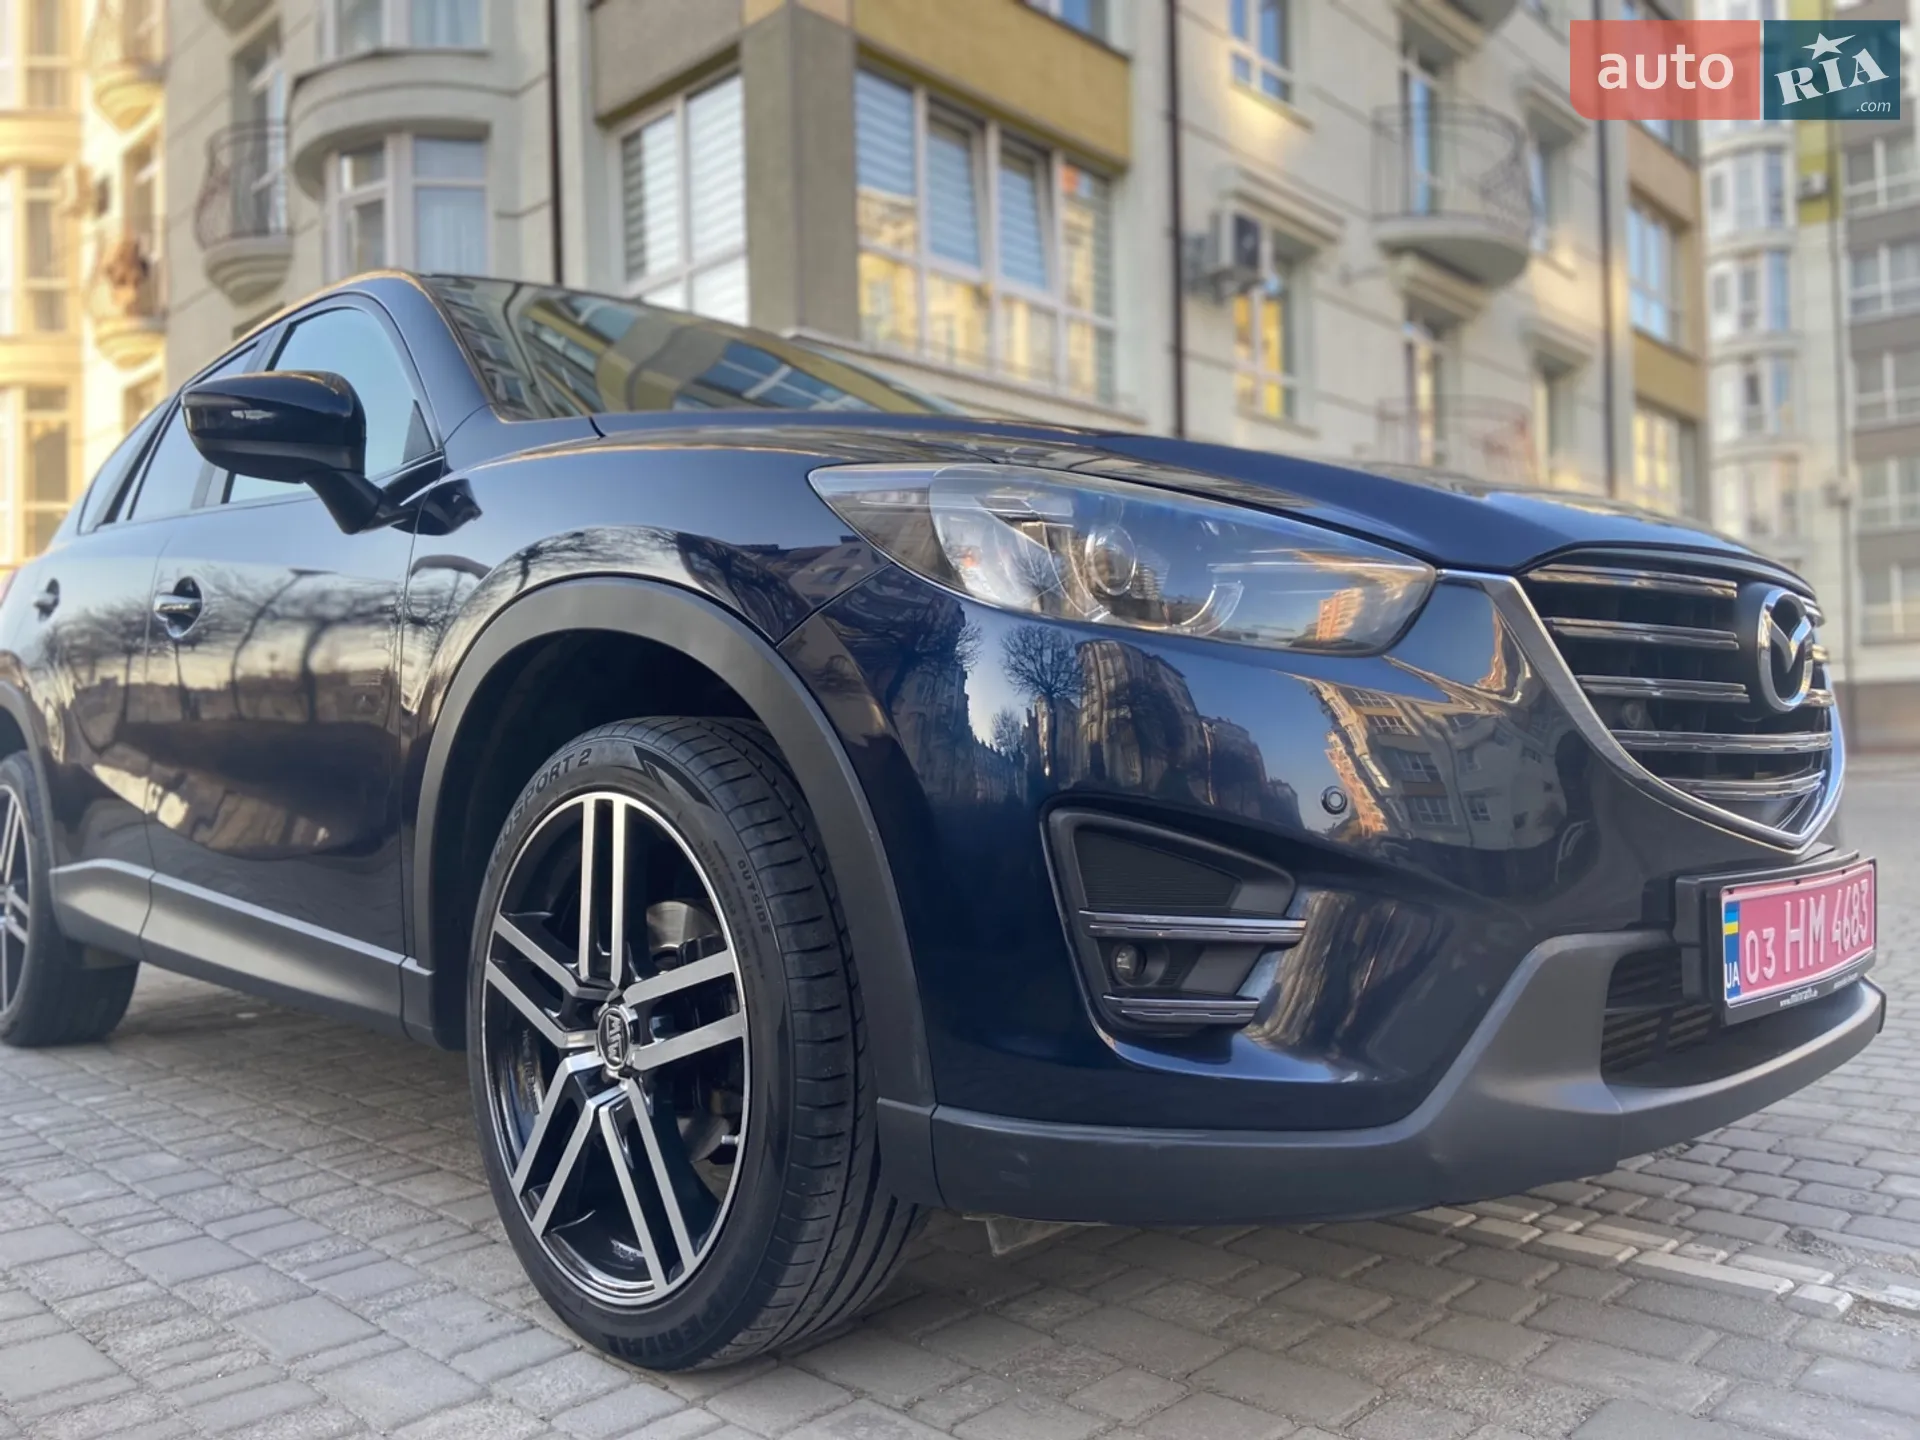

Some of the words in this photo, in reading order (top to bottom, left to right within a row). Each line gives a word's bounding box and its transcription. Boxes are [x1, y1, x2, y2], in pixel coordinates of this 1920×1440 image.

[577, 748, 592, 768] 2
[737, 859, 771, 935] OUTSIDE
[1745, 927, 1776, 984] 03
[1784, 894, 1825, 973] HM
[1832, 879, 1868, 955] 4683
[1724, 962, 1740, 988] UA
